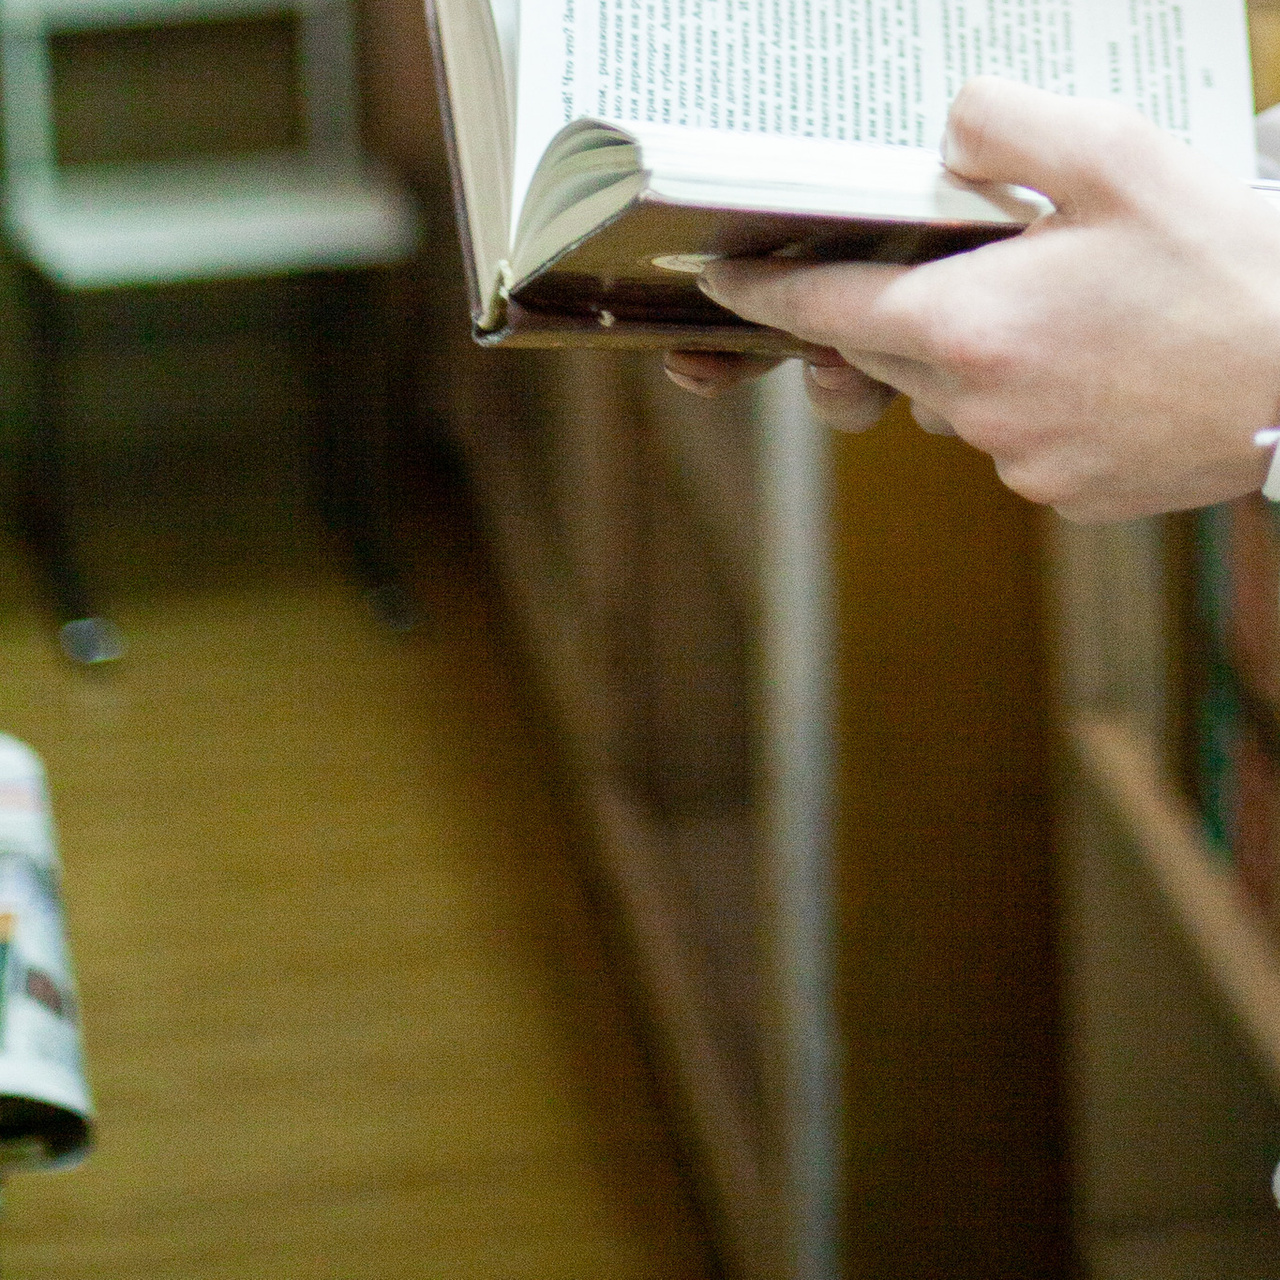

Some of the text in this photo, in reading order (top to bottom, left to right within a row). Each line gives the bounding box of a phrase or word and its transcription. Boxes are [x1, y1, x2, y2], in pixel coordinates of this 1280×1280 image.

[628, 13, 640, 29] на
[644, 3, 656, 19] он
[560, 27, 574, 55] это?
[645, 23, 659, 83] которого
[676, 23, 688, 76] человек
[560, 60, 574, 85] Что
[629, 33, 643, 93] держали
[612, 67, 624, 90] что
